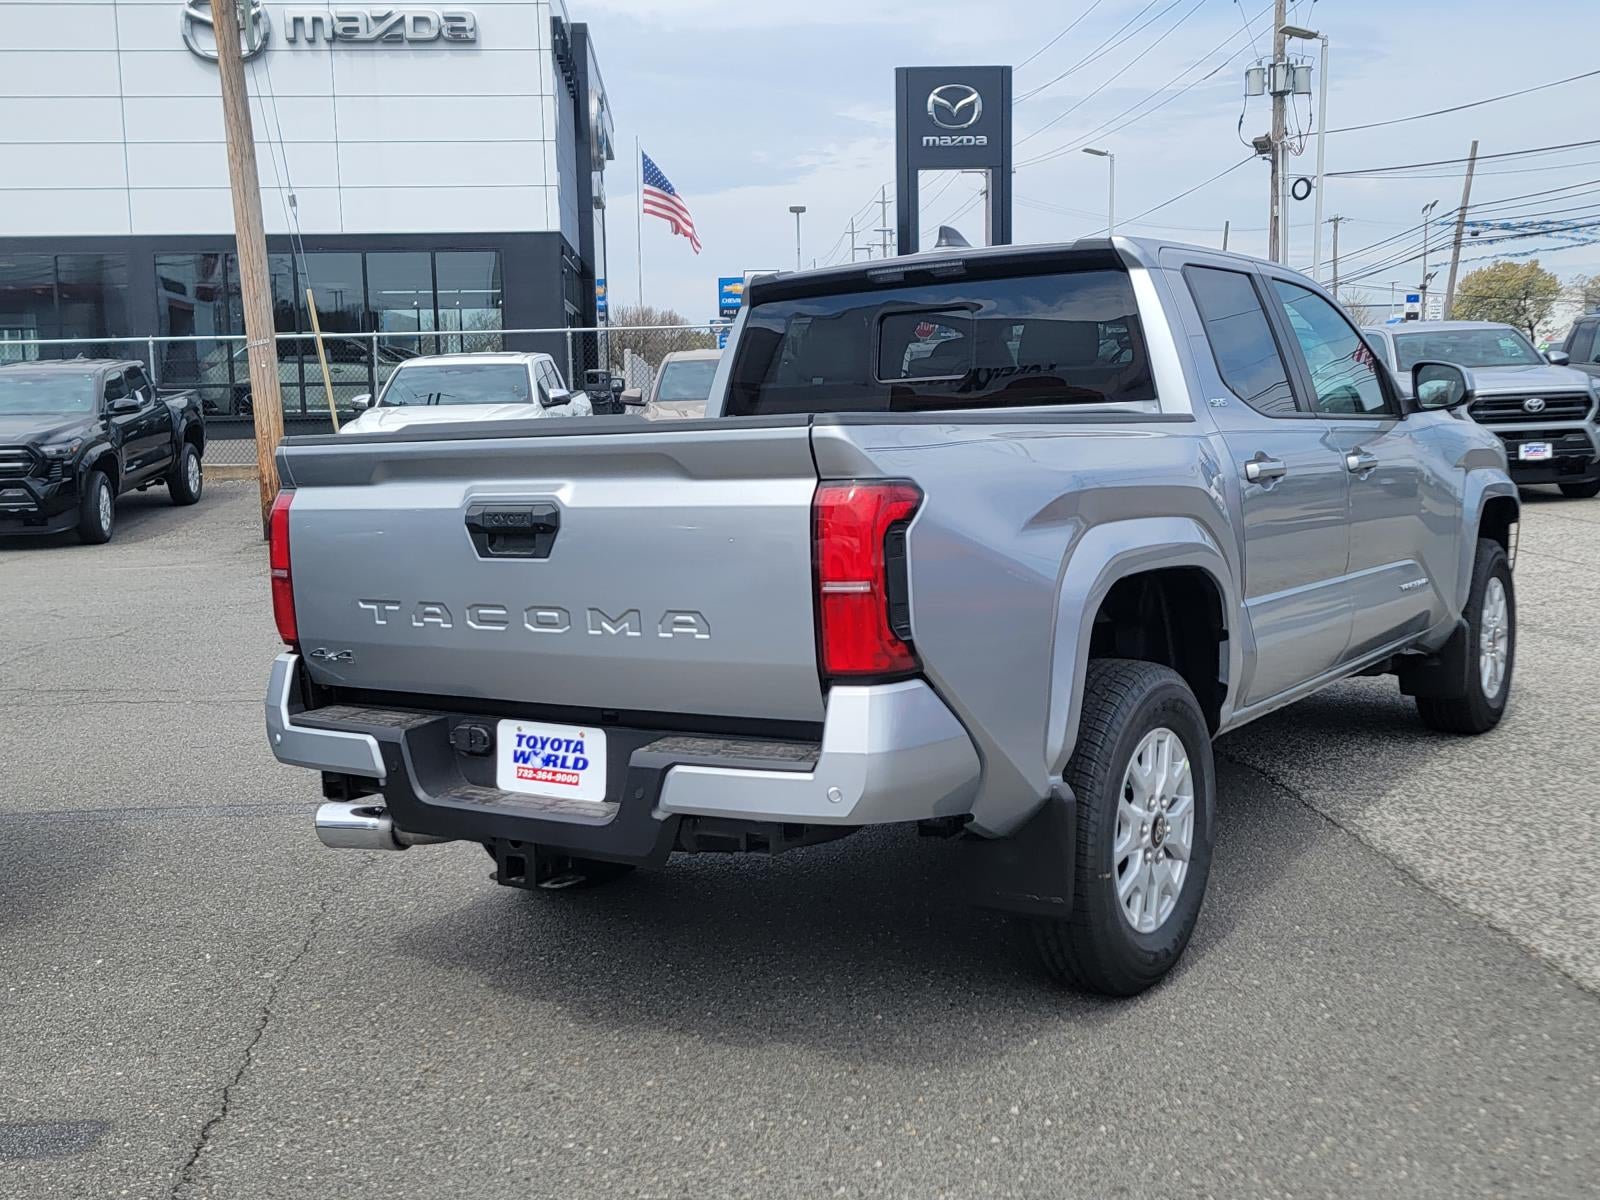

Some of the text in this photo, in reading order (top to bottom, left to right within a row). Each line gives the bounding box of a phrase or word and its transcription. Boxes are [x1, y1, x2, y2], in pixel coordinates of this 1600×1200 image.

[484, 512, 530, 525] TOYOTA
[358, 599, 711, 640] TACOMA
[515, 733, 585, 755] TOYOTA
[513, 749, 589, 771] WORLD
[517, 768, 579, 784] 732-364-9000
